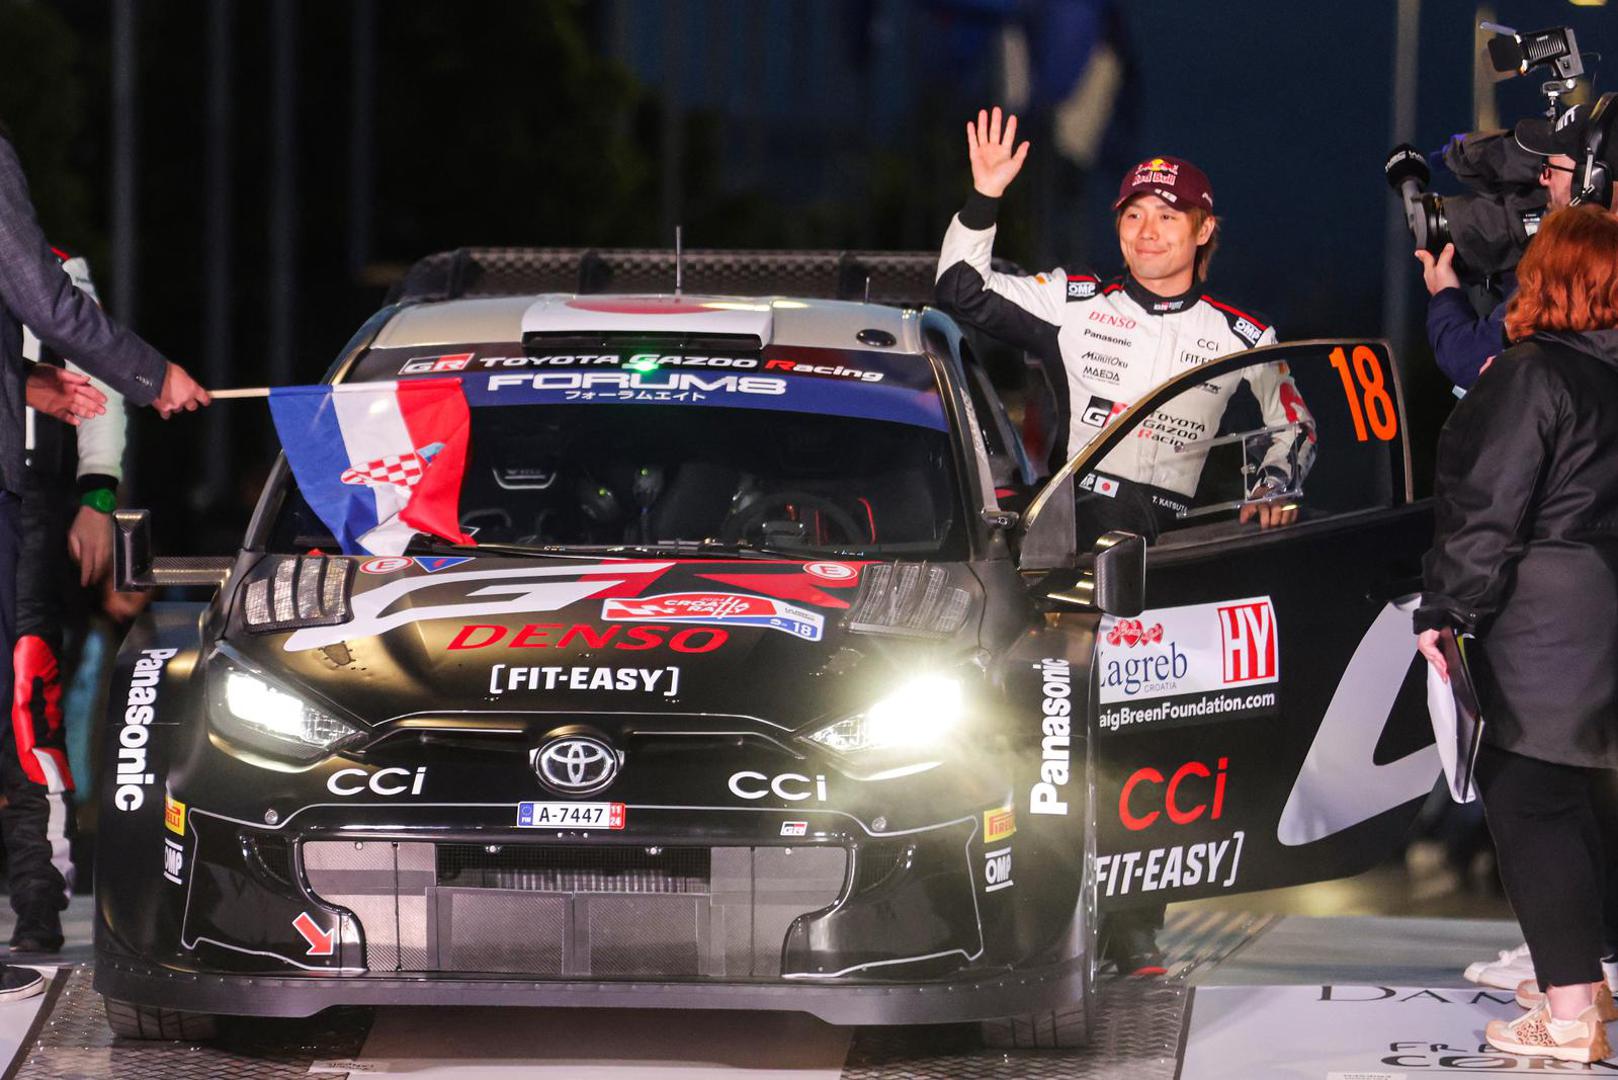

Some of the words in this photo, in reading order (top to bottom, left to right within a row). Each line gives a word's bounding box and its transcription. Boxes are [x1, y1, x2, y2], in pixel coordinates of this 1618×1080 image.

[1152, 171, 1177, 186] Bull
[1068, 284, 1096, 295] OMP
[1088, 311, 1137, 330] DENSO
[1235, 319, 1262, 341] OMP
[1084, 328, 1132, 347] Panasonic
[401, 356, 468, 375] GR
[480, 355, 620, 368] TOYOTA
[621, 354, 758, 373] GAZOO
[764, 359, 885, 383] Racing
[1082, 366, 1120, 382] MAEDA
[487, 372, 788, 395] FORUM8
[1328, 345, 1398, 442] 18
[564, 389, 707, 402] フォーラムエイト
[1142, 419, 1198, 441] GAZOO
[446, 623, 729, 653] DENSO
[793, 621, 812, 637] 18
[1219, 604, 1271, 682] HY
[1143, 682, 1177, 693] CROATIA
[115, 648, 179, 812] Panasonic
[1030, 657, 1072, 816] Panasonic
[539, 807, 604, 823] A-7447
[164, 845, 183, 877] OMP
[985, 854, 1012, 885] OMP
